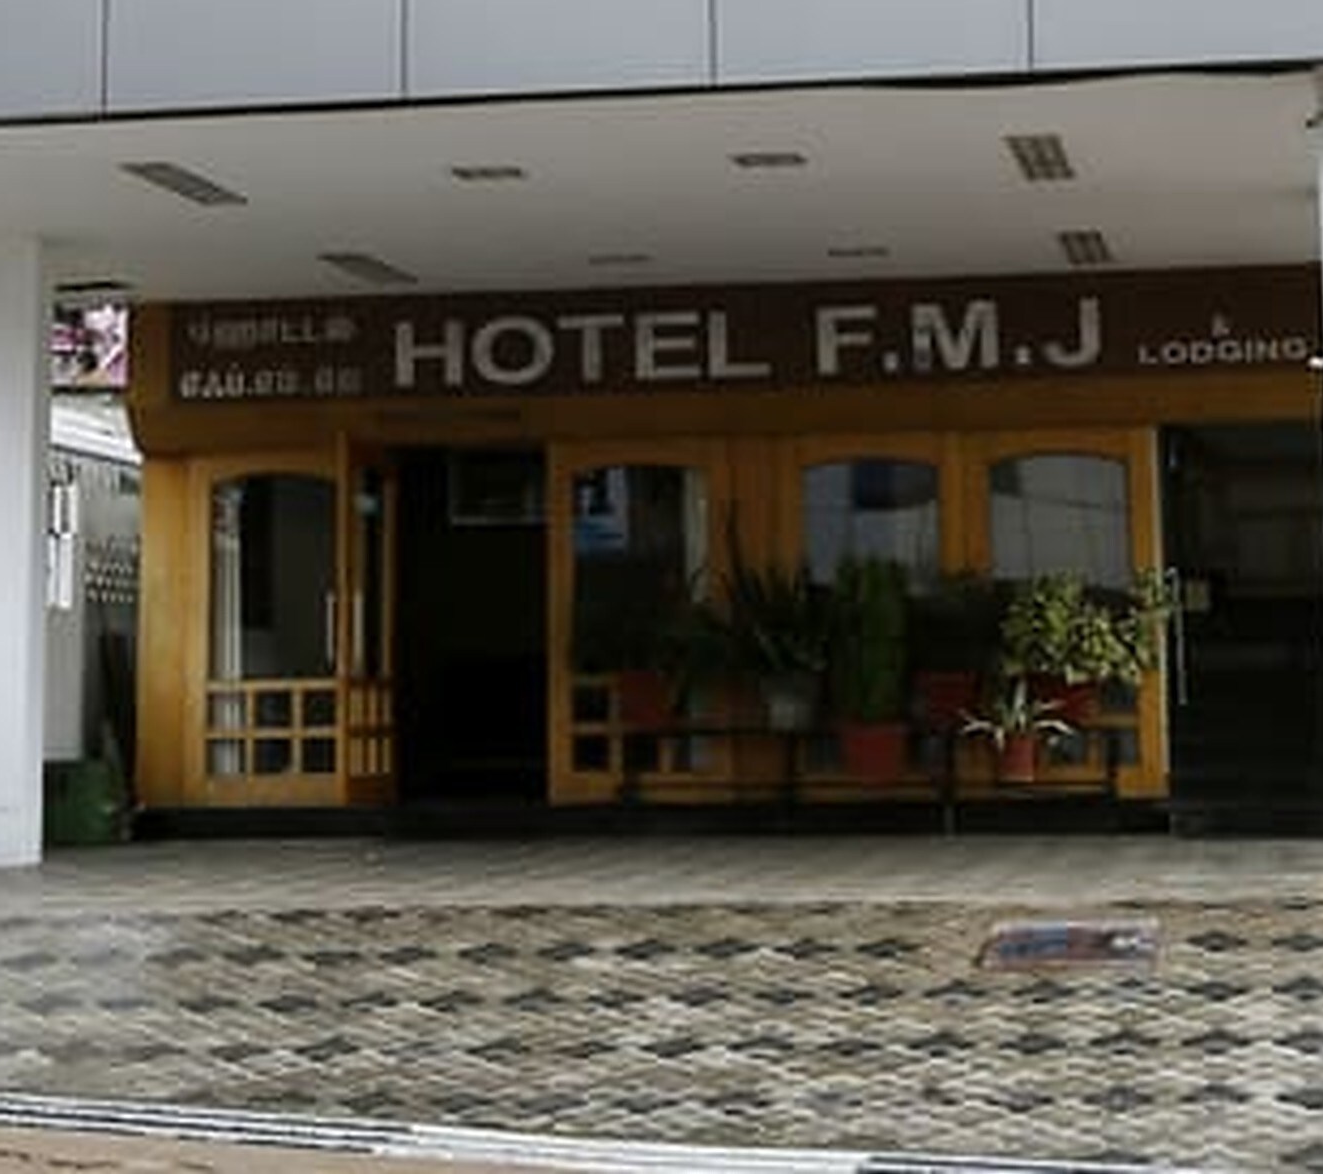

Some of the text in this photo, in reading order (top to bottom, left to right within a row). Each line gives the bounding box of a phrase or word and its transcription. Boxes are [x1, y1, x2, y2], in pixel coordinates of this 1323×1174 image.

[393, 297, 1101, 387] HOTEL F.M.J
[1137, 336, 1308, 365] LODGING
